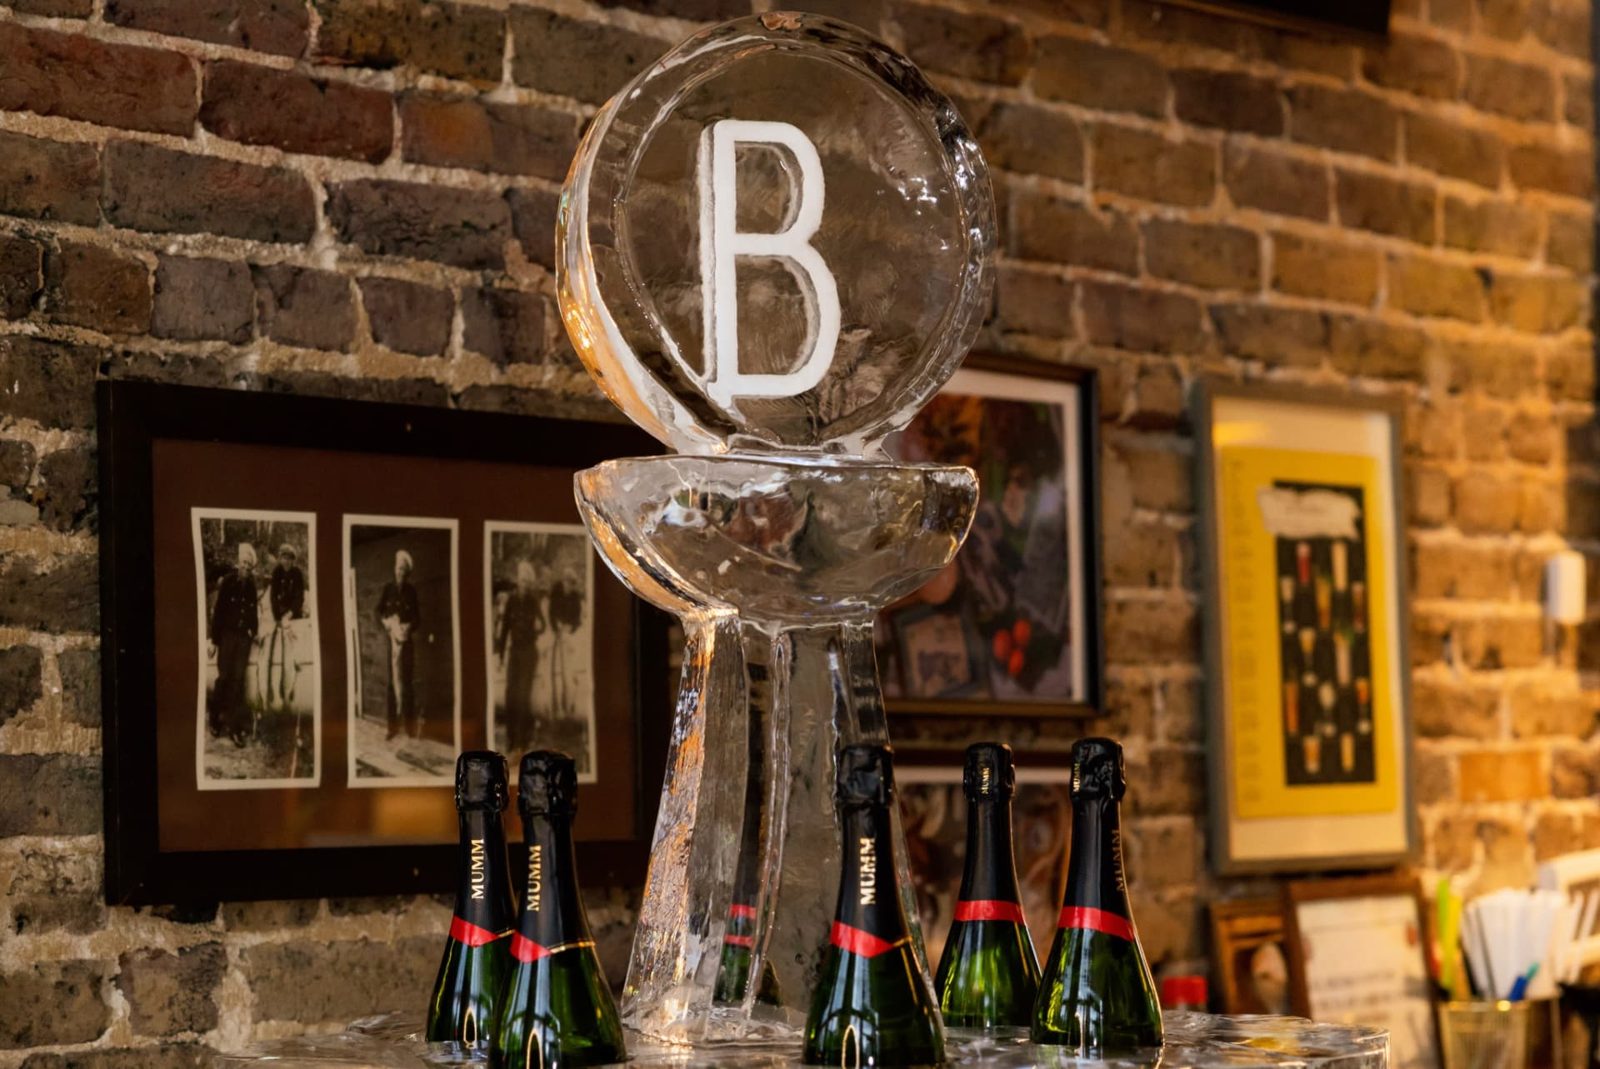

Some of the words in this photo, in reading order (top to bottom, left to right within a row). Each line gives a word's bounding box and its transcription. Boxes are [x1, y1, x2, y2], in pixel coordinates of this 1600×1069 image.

[699, 118, 842, 400] B
[471, 838, 485, 900] MUMM
[526, 844, 542, 912] MUMM
[859, 836, 876, 905] MUMM
